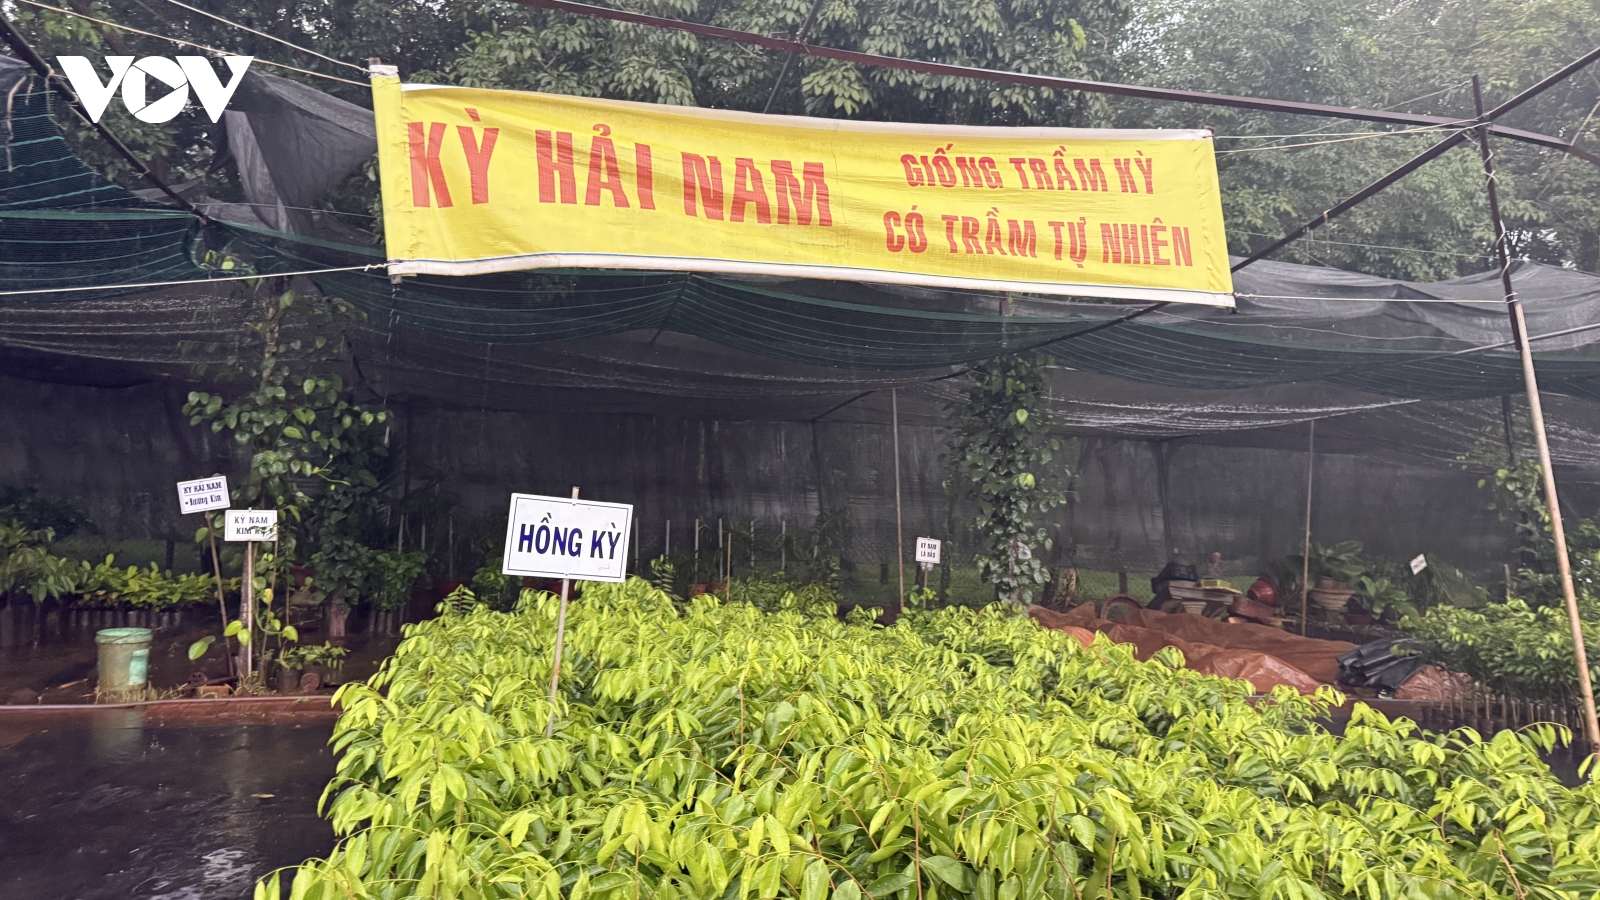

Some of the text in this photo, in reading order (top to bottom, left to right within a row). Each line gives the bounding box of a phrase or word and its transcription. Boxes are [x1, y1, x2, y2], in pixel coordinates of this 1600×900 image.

[407, 108, 832, 227] KỲ HẢI NAM
[900, 143, 1154, 195] GIỐNG TRẦM KỲ
[883, 205, 1193, 269] CÓ TRẦM TỰ NHIÊN
[248, 516, 268, 524] NAM
[517, 512, 621, 560] HỒNG KỲ
